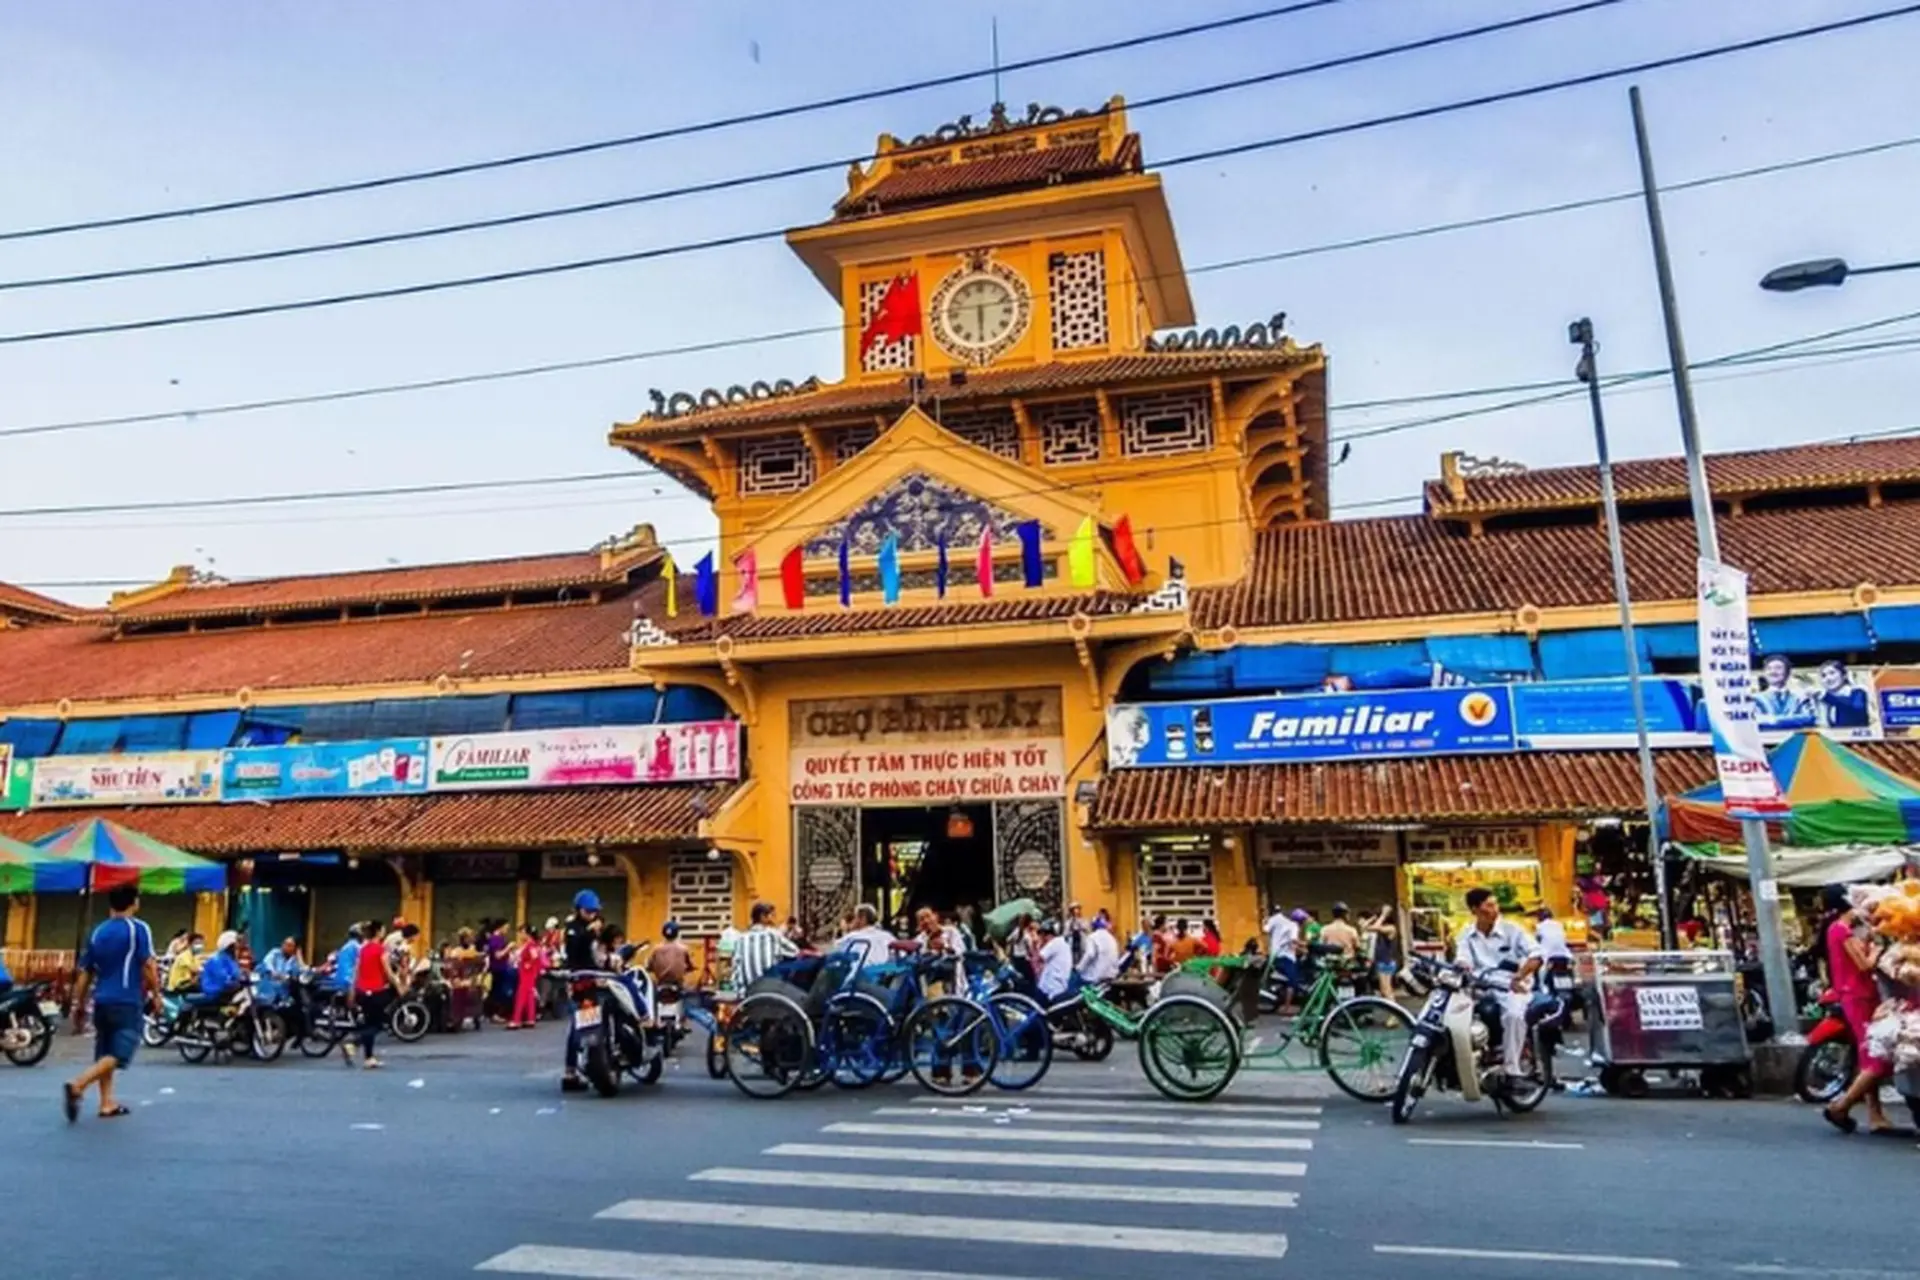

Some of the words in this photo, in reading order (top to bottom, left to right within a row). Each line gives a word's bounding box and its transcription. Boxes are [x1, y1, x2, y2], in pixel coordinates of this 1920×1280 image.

[1249, 706, 1434, 740] Familiar
[455, 748, 531, 766] FAMILIAR
[805, 752, 860, 775] QUYẾT
[867, 752, 904, 771] TÂM
[910, 751, 958, 772] THỰC
[963, 749, 1006, 769] HIỆN
[1012, 744, 1047, 766] TỐT
[793, 778, 832, 799] CÔNG
[836, 780, 866, 799] TÁC
[869, 777, 922, 797] PHÒNG
[926, 777, 967, 797] CHÁY
[971, 774, 1013, 795] CHỮA
[1018, 773, 1060, 793] CHÁY
